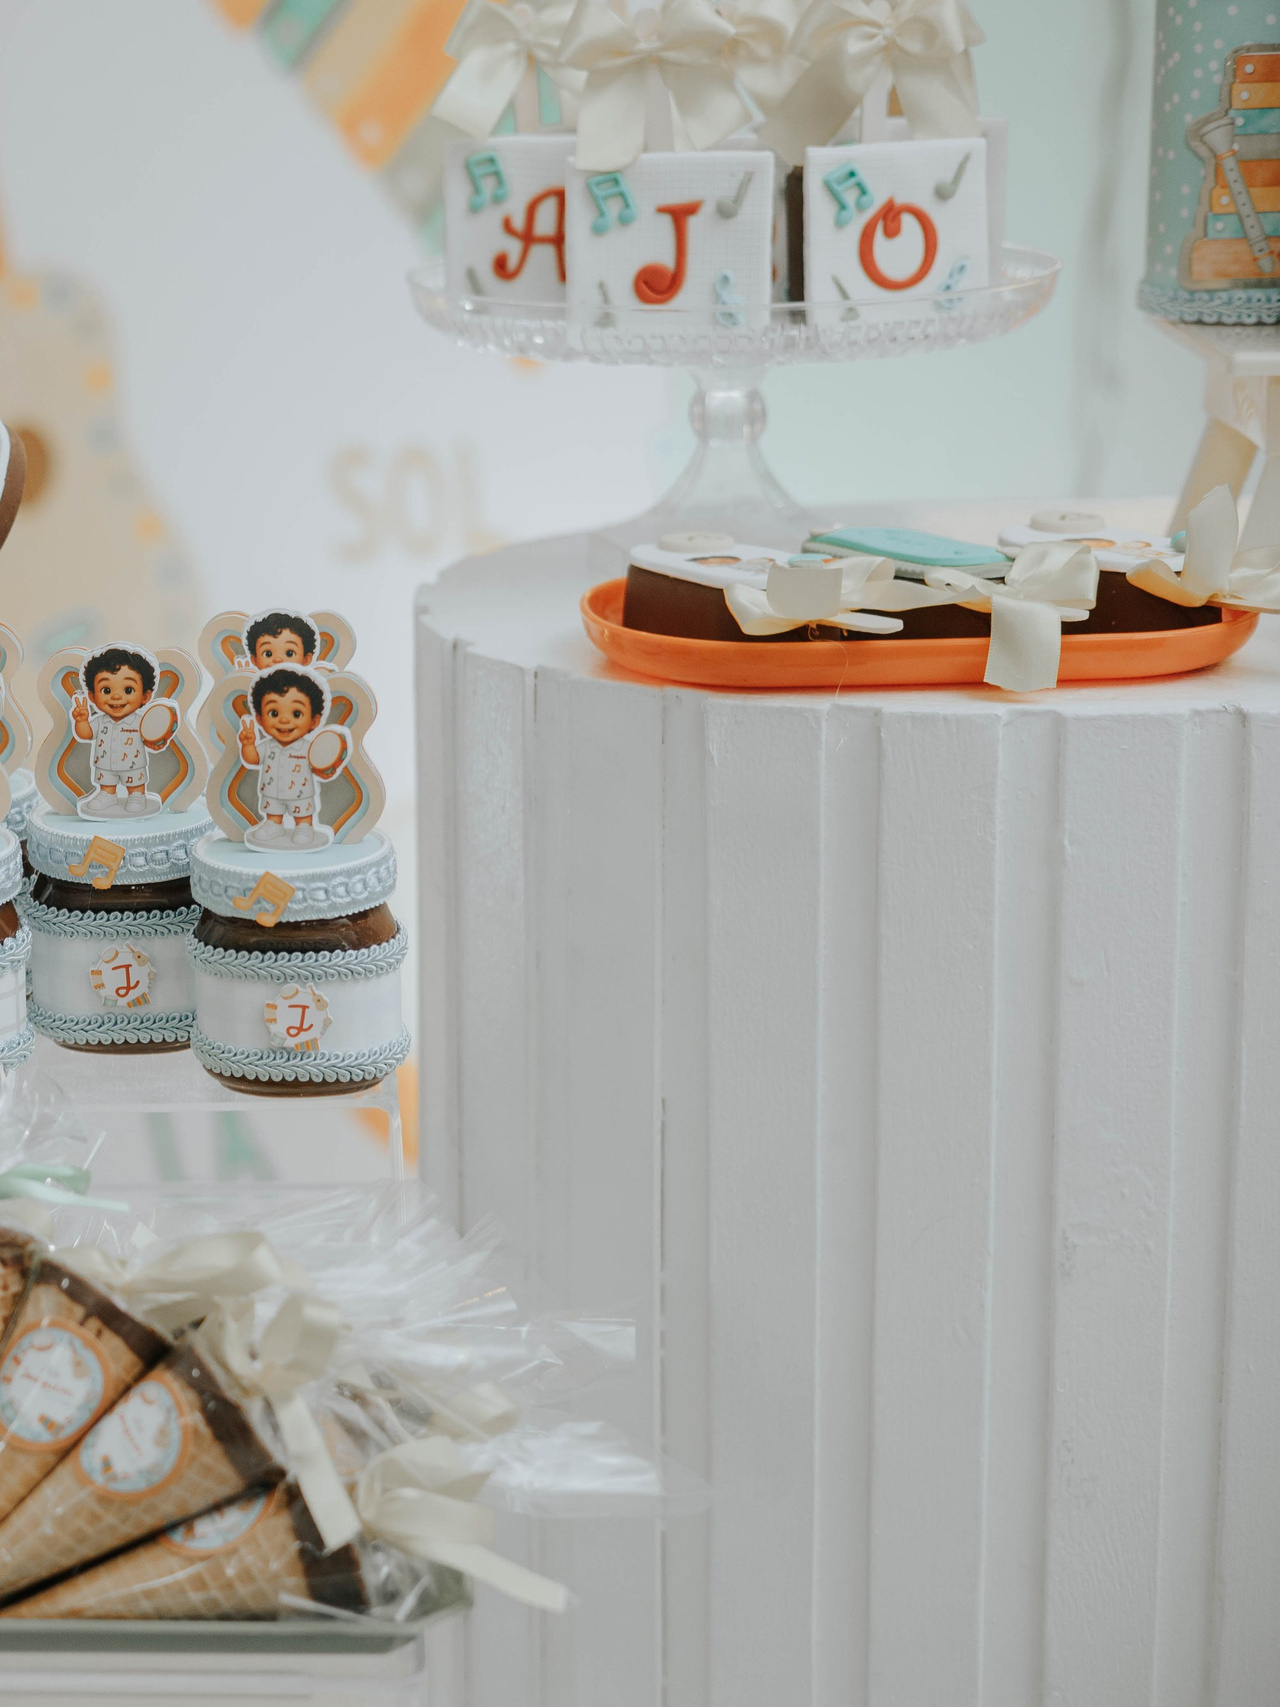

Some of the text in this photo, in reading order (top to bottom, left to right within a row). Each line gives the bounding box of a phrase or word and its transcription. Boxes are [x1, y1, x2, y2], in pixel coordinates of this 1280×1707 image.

[633, 201, 703, 304] J
[858, 197, 938, 291] O
[111, 963, 140, 998] J
[286, 1004, 314, 1038] J
